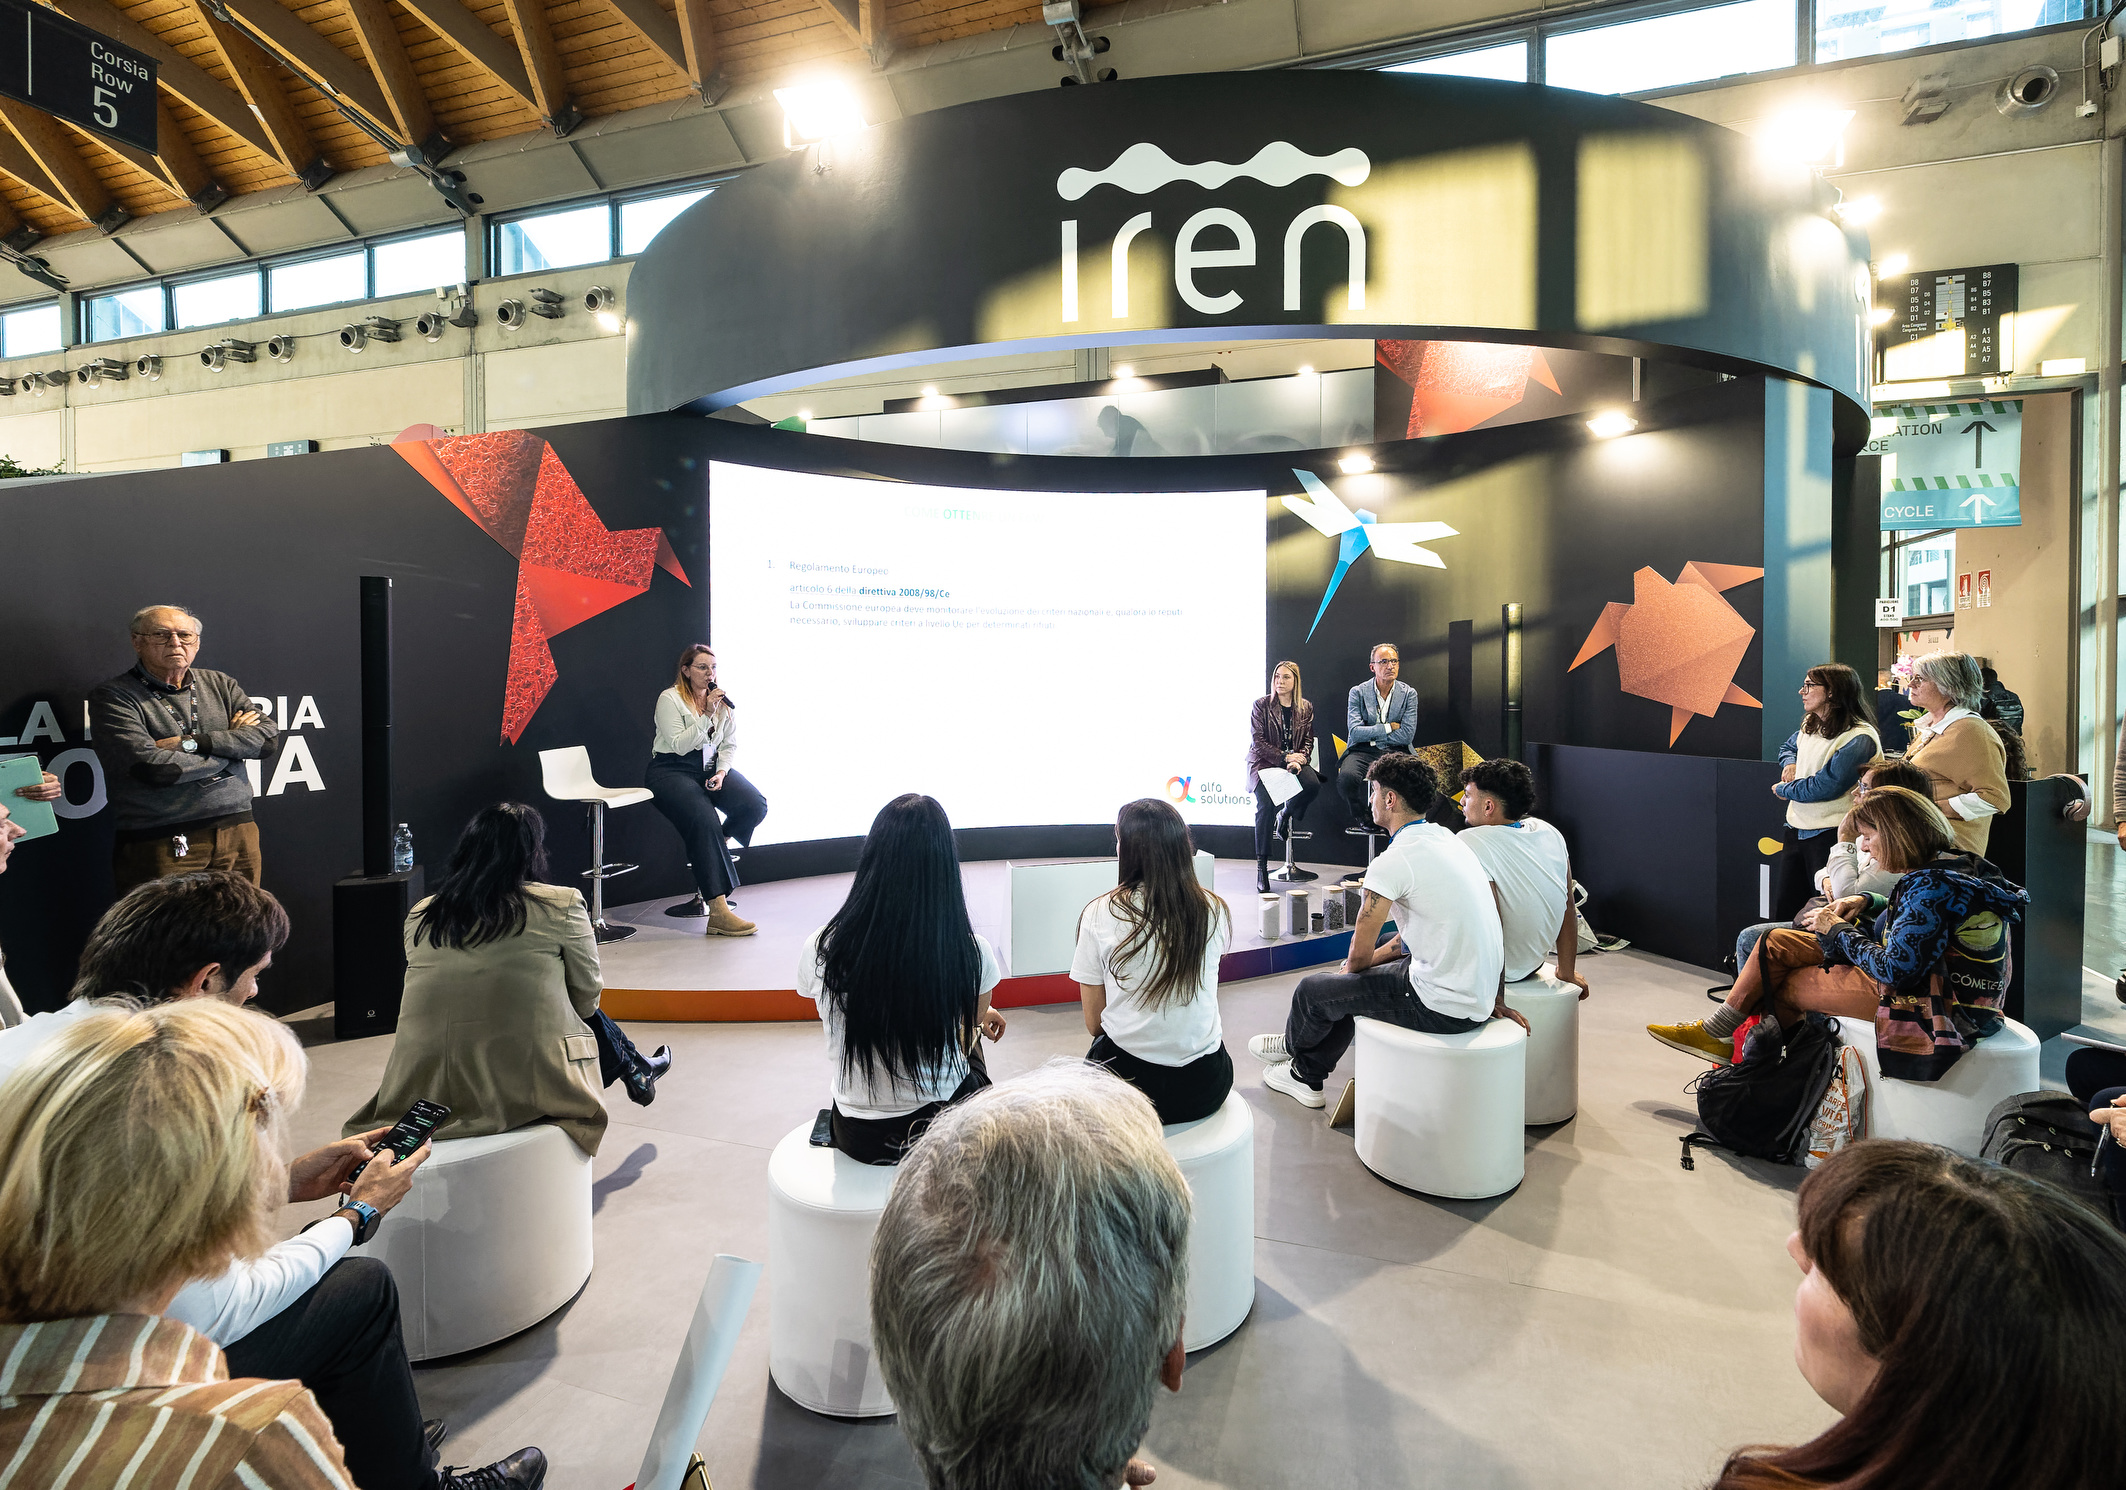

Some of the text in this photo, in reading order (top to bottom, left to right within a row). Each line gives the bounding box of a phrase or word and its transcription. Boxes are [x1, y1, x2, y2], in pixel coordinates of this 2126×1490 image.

[91, 41, 149, 81] Corsia
[91, 62, 133, 94] Row
[93, 85, 118, 129] 5
[1061, 204, 1367, 323] iren
[1882, 423, 1942, 437] ATION
[1884, 505, 1934, 518] CYCLE
[789, 561, 850, 573] Regolamento
[789, 584, 950, 599] articolo 6 della direttiva 2008/98/Ce
[790, 600, 800, 609] La
[802, 600, 863, 612] Commissione
[865, 604, 902, 613] europea
[903, 605, 924, 613] deve
[926, 606, 974, 614] monitorare
[790, 616, 841, 626] necessario,
[843, 617, 888, 627] sviluppare
[925, 619, 950, 627] livello
[952, 620, 964, 628] Ue
[966, 621, 980, 629] per
[1200, 781, 1222, 793] alfa
[1200, 794, 1251, 805] solutions
[1821, 1105, 1843, 1123] VITA
